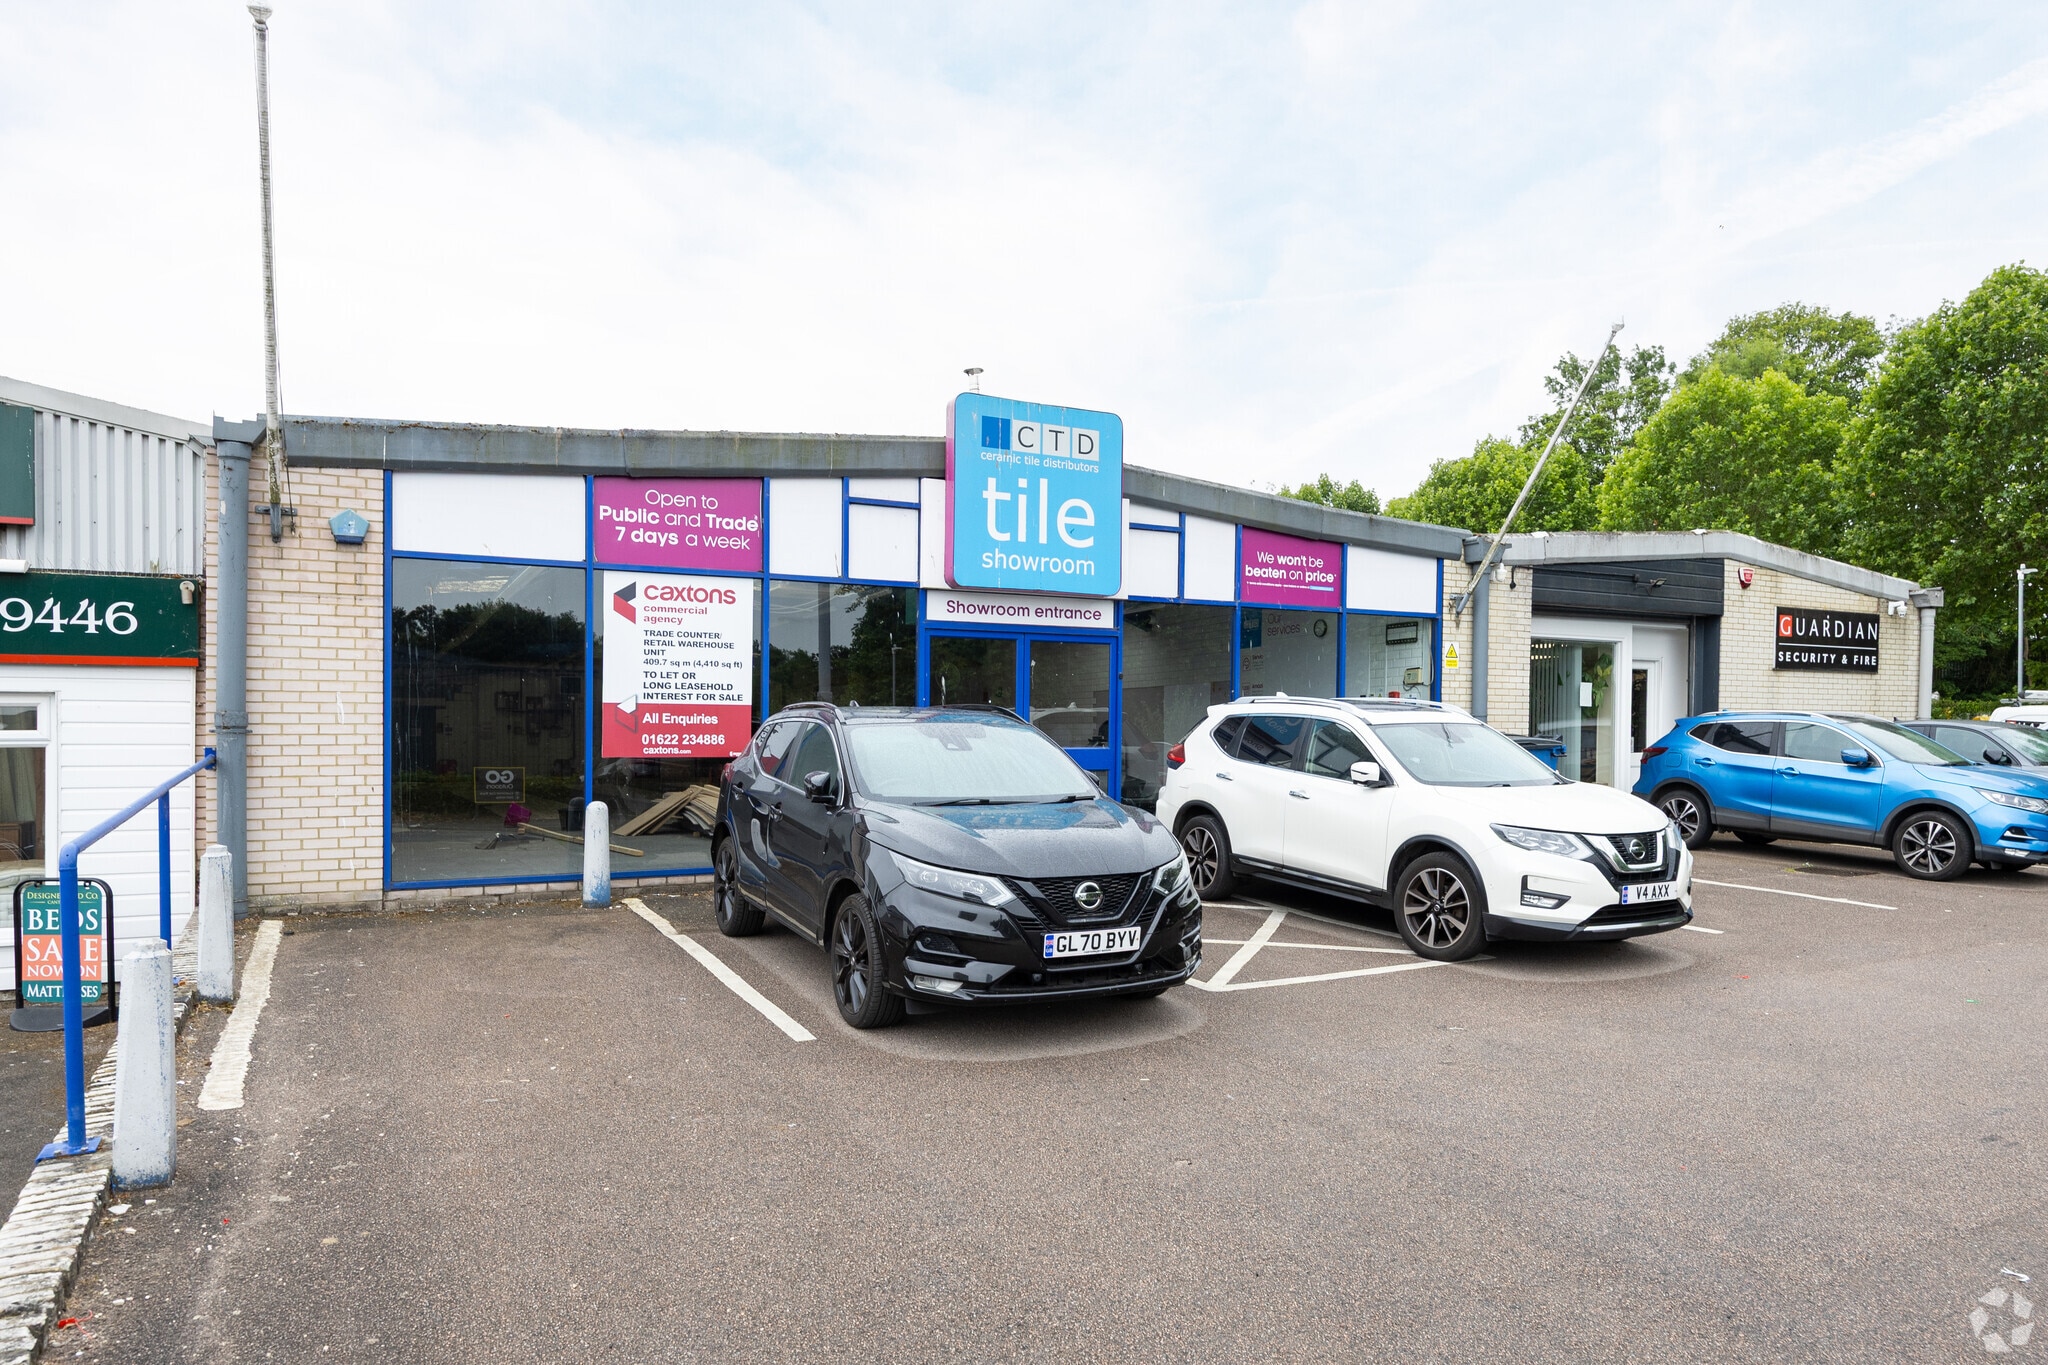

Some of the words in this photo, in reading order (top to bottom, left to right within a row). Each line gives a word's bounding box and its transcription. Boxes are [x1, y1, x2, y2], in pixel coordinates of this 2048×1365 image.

[1017, 426, 1094, 455] CTD
[980, 451, 1022, 465] ceramic
[1024, 455, 1040, 467] tile
[1043, 457, 1099, 474] distributors
[645, 489, 697, 508] Open
[701, 495, 718, 510] to
[599, 505, 660, 524] Public
[664, 513, 701, 527] and
[705, 513, 759, 532] Trade
[982, 477, 1095, 549] tile
[615, 526, 626, 541] 7
[630, 527, 679, 547] days
[685, 534, 698, 547] a
[702, 535, 751, 550] week
[981, 548, 1095, 576] showroom
[1257, 551, 1274, 564] We
[1277, 555, 1307, 567] won't
[1308, 556, 1324, 568] be
[1245, 564, 1286, 579] beaten
[1289, 570, 1303, 581] on
[643, 584, 737, 605] caxtons
[0, 597, 138, 635] 9446
[643, 605, 708, 615] commercial
[946, 600, 1030, 617] Showroom
[1034, 605, 1102, 621] entrance
[643, 615, 683, 625] agency
[1780, 616, 1878, 640] GUARDIAN
[643, 629, 674, 637] TRADE
[1266, 624, 1301, 637] services
[677, 640, 735, 649] WAREHOUSE
[693, 660, 719, 668] (4,410
[1778, 651, 1836, 664] SECURITY
[1841, 654, 1848, 665] &
[1853, 655, 1877, 665] FIRE
[643, 671, 657, 679] TO
[643, 681, 672, 690] LONG
[674, 682, 734, 691] LEASEHOLD
[643, 692, 693, 700] INTEREST
[696, 693, 716, 701] FOR
[718, 693, 743, 702] SALE
[642, 712, 659, 724] All
[662, 713, 719, 727] Enquiries
[641, 733, 679, 745] 01622
[682, 734, 726, 746] 234886
[643, 746, 692, 755] caxtons.com
[26, 891, 61, 900] DESIGNE
[1636, 885, 1649, 900] V4
[1651, 884, 1670, 899] AXX
[1056, 935, 1078, 953] GL
[1080, 933, 1101, 951] 70
[1106, 929, 1137, 949] BYV
[26, 937, 99, 962] SAE
[26, 983, 98, 998] MATTSES
